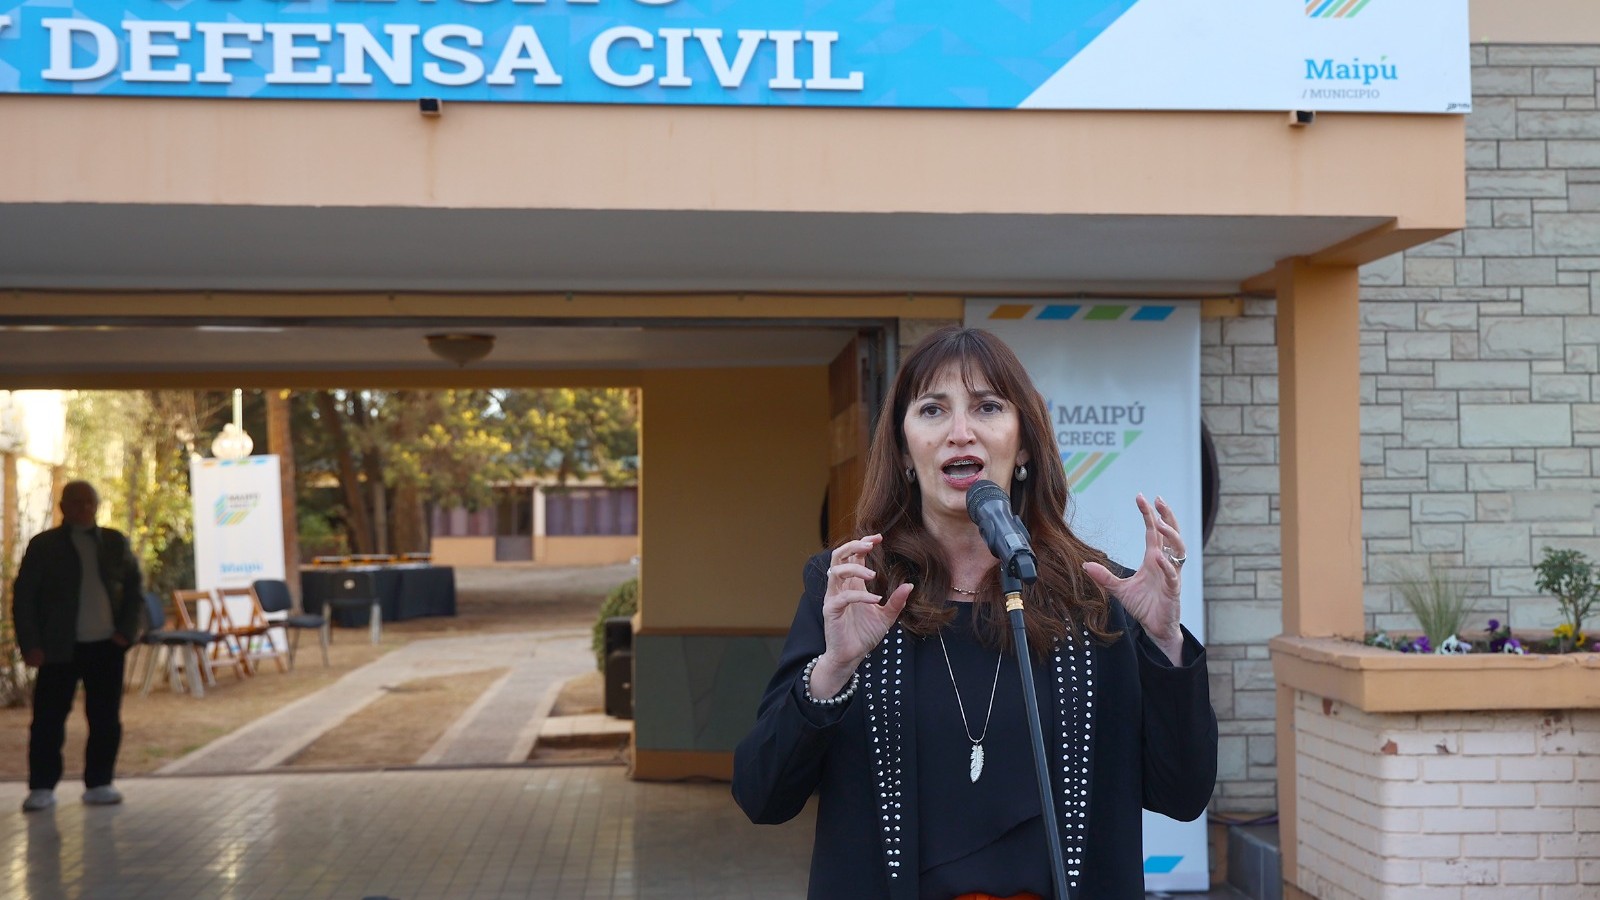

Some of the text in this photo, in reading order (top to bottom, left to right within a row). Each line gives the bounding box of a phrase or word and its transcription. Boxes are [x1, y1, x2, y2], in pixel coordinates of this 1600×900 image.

[41, 17, 562, 85] DEFENSA
[588, 25, 864, 91] CIVIL
[1304, 55, 1398, 84] Maipú
[1310, 88, 1379, 99] MUNICIPIO
[1057, 401, 1145, 425] MAIPÚ
[1058, 431, 1116, 446] CRECE
